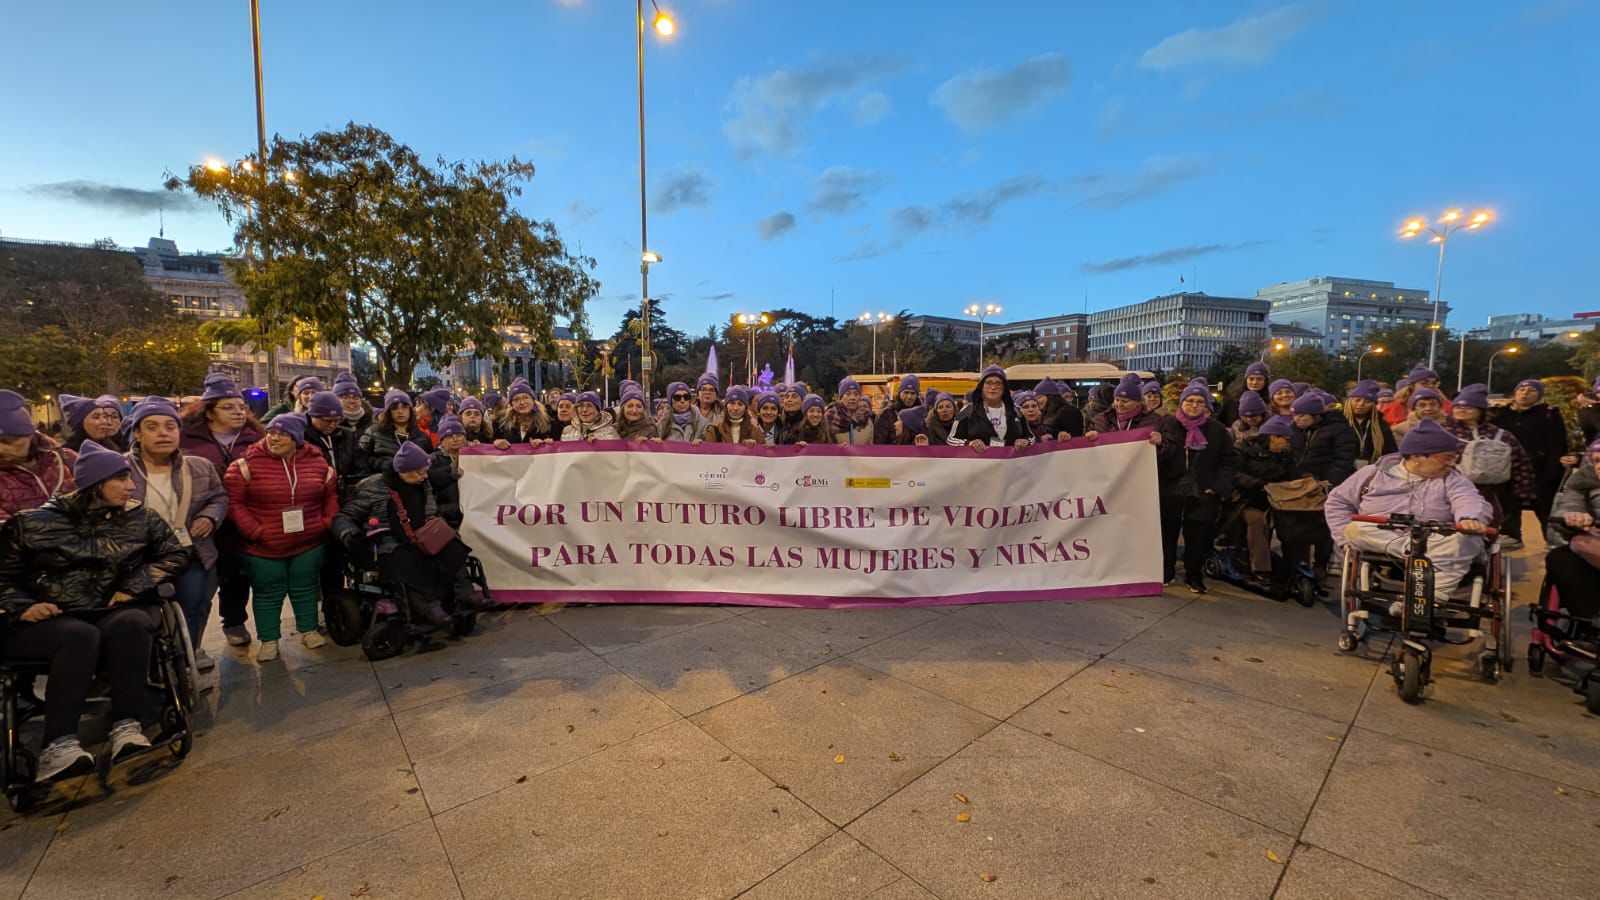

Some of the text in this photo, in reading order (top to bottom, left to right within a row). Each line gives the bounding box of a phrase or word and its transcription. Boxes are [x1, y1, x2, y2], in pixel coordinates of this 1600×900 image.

[496, 495, 1109, 529] POR UN FUTURO LIBRE DE VIOLENCIA
[530, 535, 1091, 574] PARA TODAS LAS MUJERES Y NIÑAS
[1413, 559, 1428, 597] Empulse
